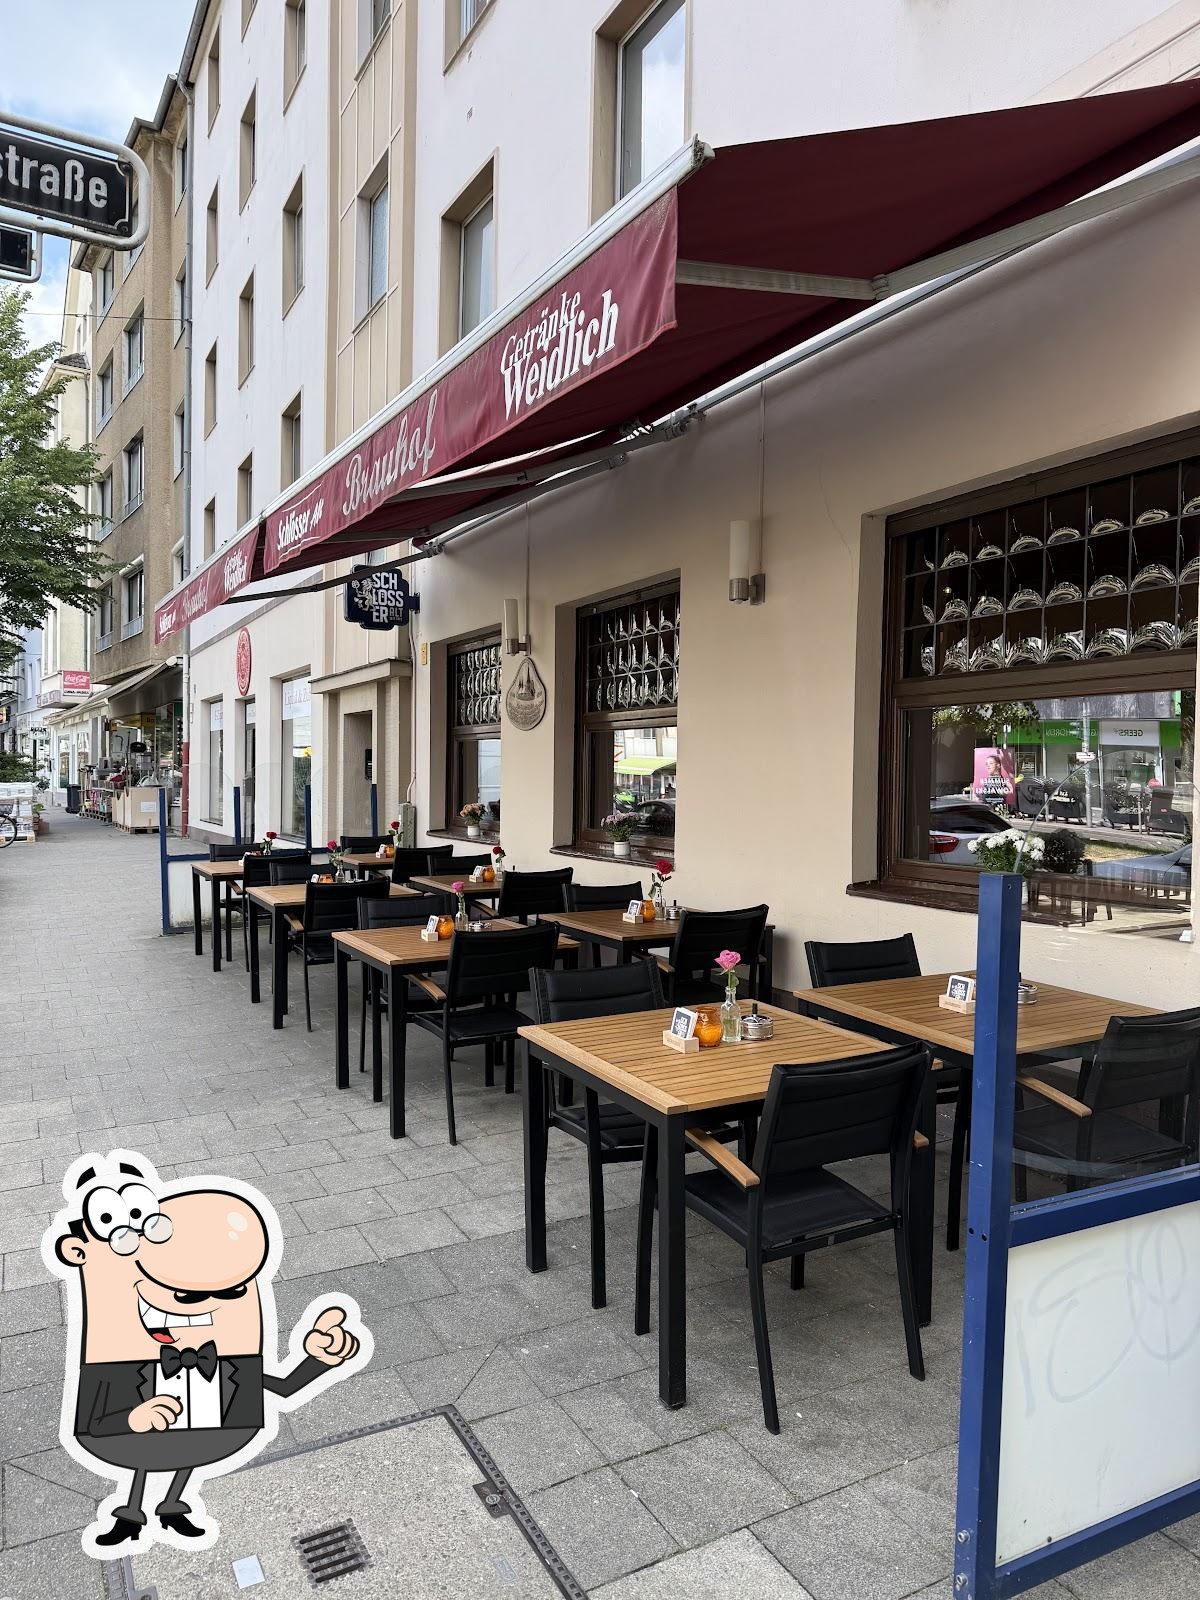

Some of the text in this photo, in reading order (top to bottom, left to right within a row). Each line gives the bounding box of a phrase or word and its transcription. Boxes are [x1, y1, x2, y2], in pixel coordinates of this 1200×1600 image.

[0, 144, 108, 208] traße
[500, 291, 581, 374] Getränke
[503, 288, 619, 421] Weidlich
[342, 388, 438, 516] Brauhof
[277, 508, 311, 551] Schlösser
[371, 571, 398, 590] SCH
[372, 605, 389, 623] ER
